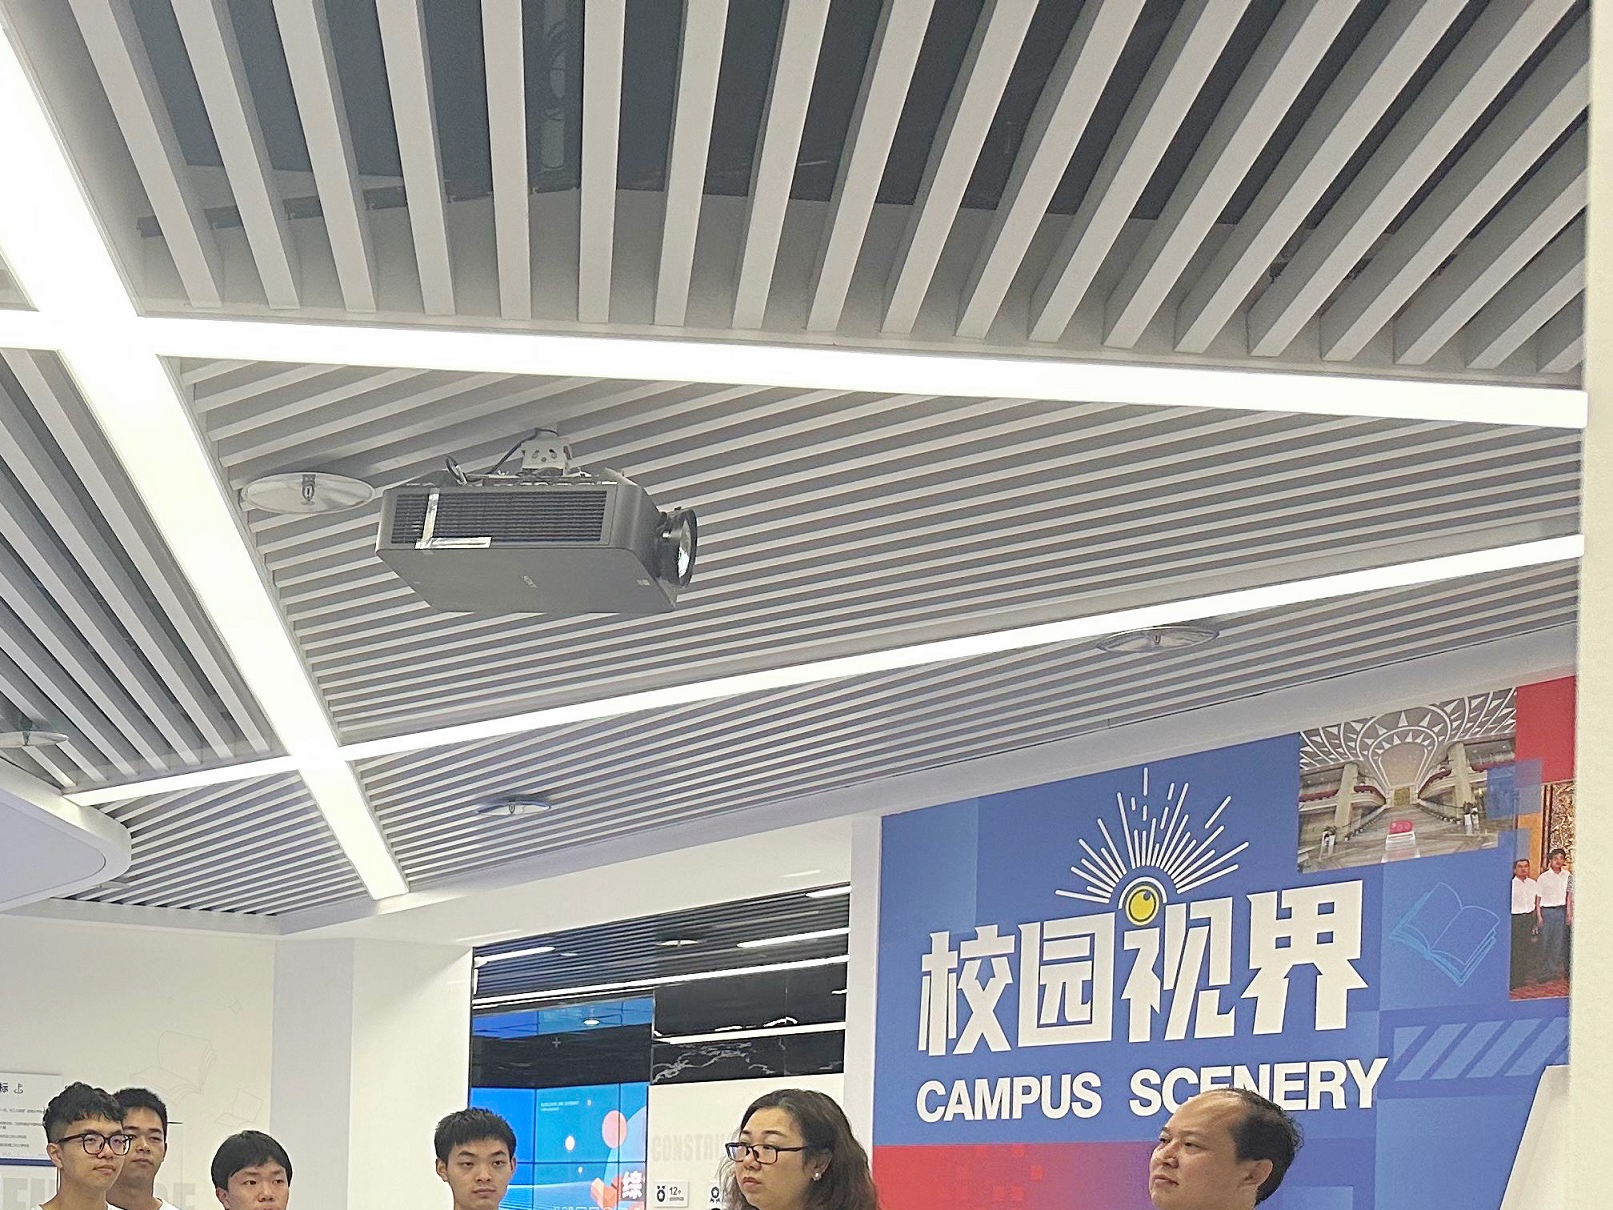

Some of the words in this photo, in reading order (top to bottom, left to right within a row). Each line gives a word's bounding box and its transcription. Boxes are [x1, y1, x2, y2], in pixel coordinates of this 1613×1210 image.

[917, 879, 1368, 1057] 校园视界
[916, 1072, 1102, 1123] CAMPUS
[622, 1170, 643, 1200] 综
